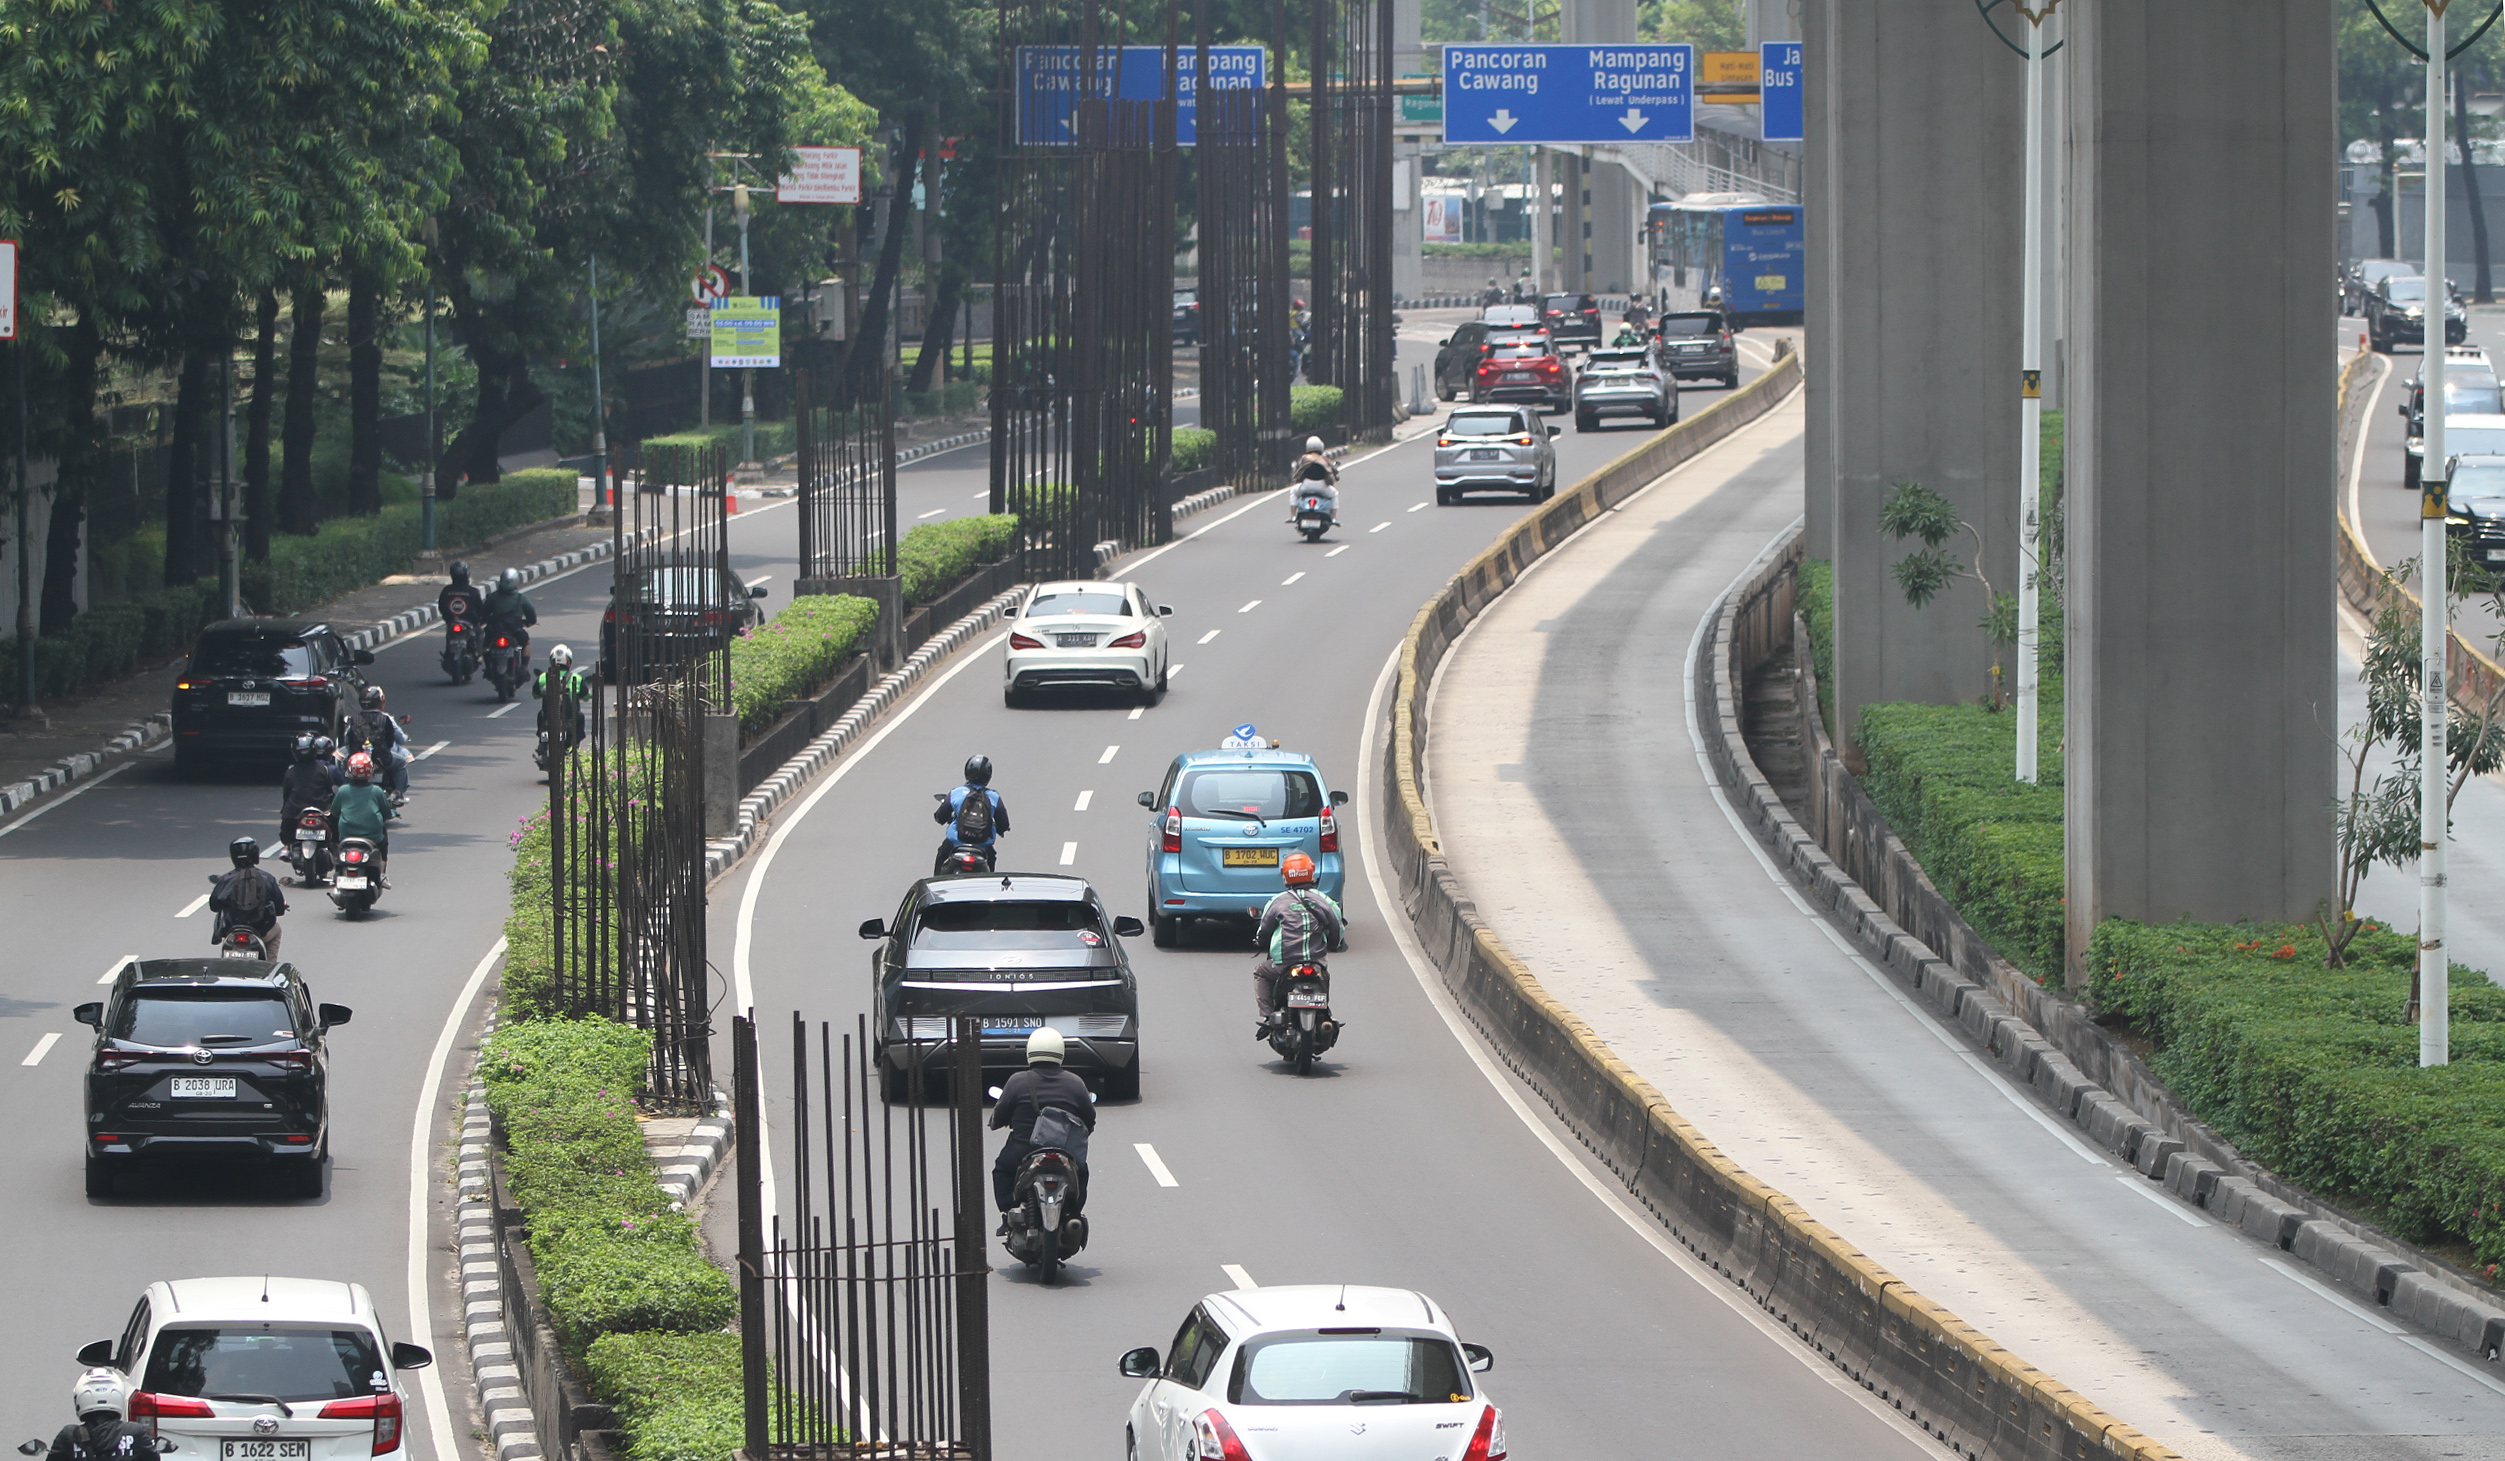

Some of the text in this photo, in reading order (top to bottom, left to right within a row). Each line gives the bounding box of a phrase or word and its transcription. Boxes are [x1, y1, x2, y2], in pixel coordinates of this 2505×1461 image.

[1162, 52, 1256, 75] apang
[1451, 51, 1547, 69] Pancoran
[1589, 50, 1685, 72] Mampang
[1459, 71, 1539, 95] Cawang
[1594, 72, 1680, 94] Ragunan
[1765, 69, 1794, 87] Bus
[1225, 850, 1231, 859] B
[1236, 850, 1257, 859] 1702
[983, 1018, 990, 1028] B
[995, 1018, 1019, 1028] 1591
[173, 1080, 234, 1091] B 2038 URA
[1435, 1422, 1464, 1430] SWIFT
[225, 1442, 305, 1457] B 1622 SEM
